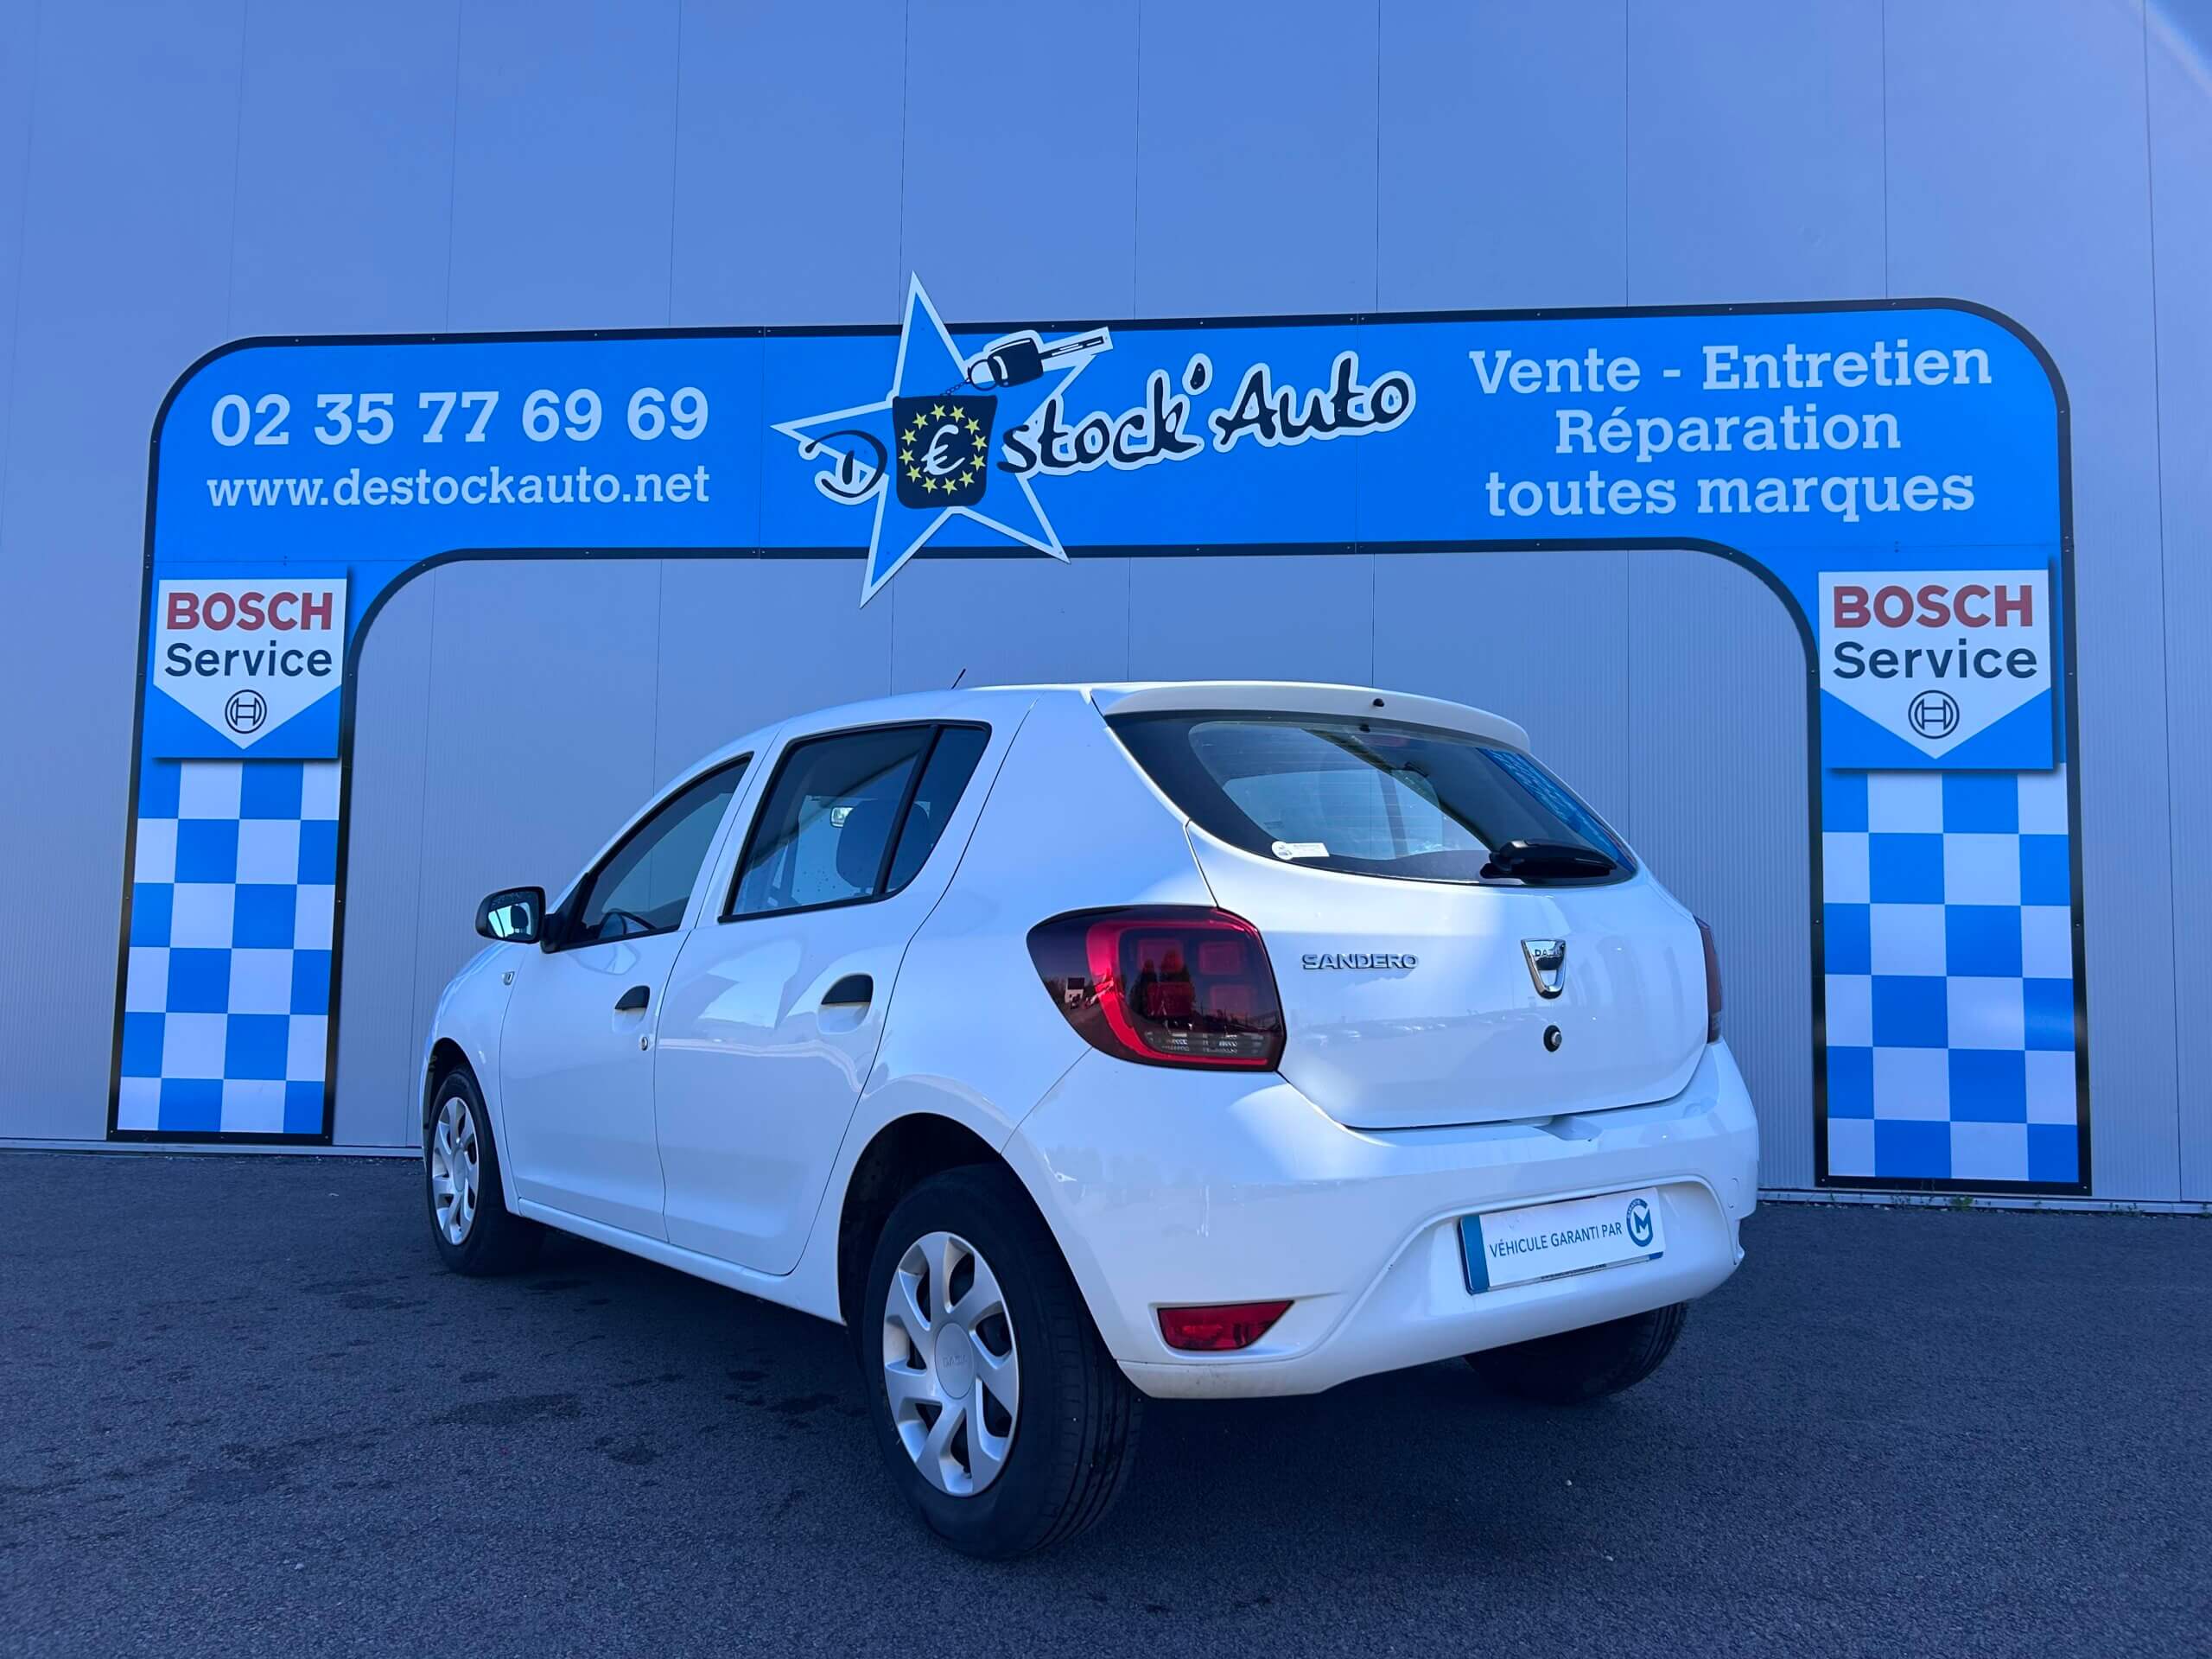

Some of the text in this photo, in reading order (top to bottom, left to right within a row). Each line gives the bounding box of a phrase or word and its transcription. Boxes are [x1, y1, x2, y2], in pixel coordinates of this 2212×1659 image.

[1469, 340, 1992, 394] Vente - Entretien
[211, 386, 709, 447] 02 35 77 69 69
[1554, 403, 1901, 462] Réparation
[207, 464, 710, 506] www.destockauto.net
[1485, 470, 1975, 522] toutes marques
[166, 591, 334, 631] BOSCH
[1833, 584, 2034, 628] BOSCH
[163, 639, 333, 677] Service
[1833, 638, 2038, 680] Service
[1302, 953, 1418, 969] SANDERO
[1489, 1222, 1623, 1258] VÉHICULE GARANTI PAR
